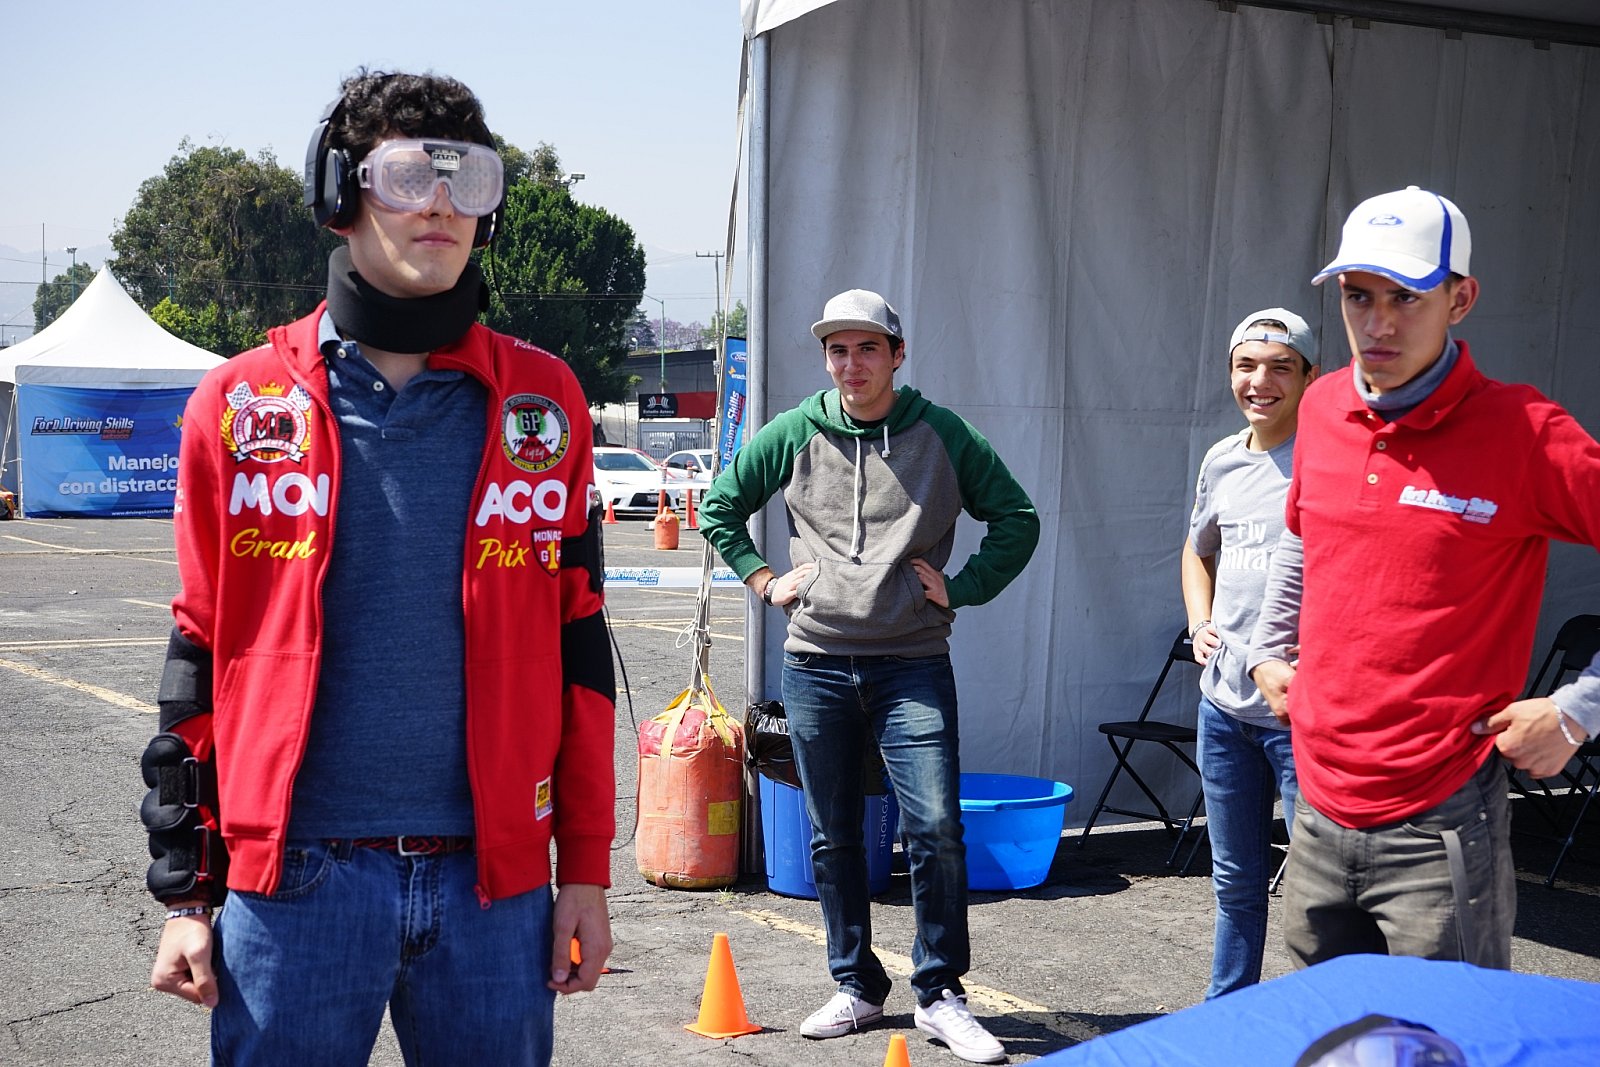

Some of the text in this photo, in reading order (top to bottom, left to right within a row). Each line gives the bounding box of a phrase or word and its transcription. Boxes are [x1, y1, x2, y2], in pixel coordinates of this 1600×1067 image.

[63, 416, 102, 434] Driving
[105, 416, 134, 430] Skills
[250, 411, 293, 441] MC
[521, 413, 540, 431] GP
[109, 454, 180, 472] Manejo
[59, 478, 177, 495] con distracc
[229, 472, 330, 517] MON
[475, 479, 567, 527] ACO
[230, 528, 317, 559] Grand
[533, 530, 562, 542] MONAC
[1237, 520, 1267, 544] Fly
[476, 538, 530, 570] Prix
